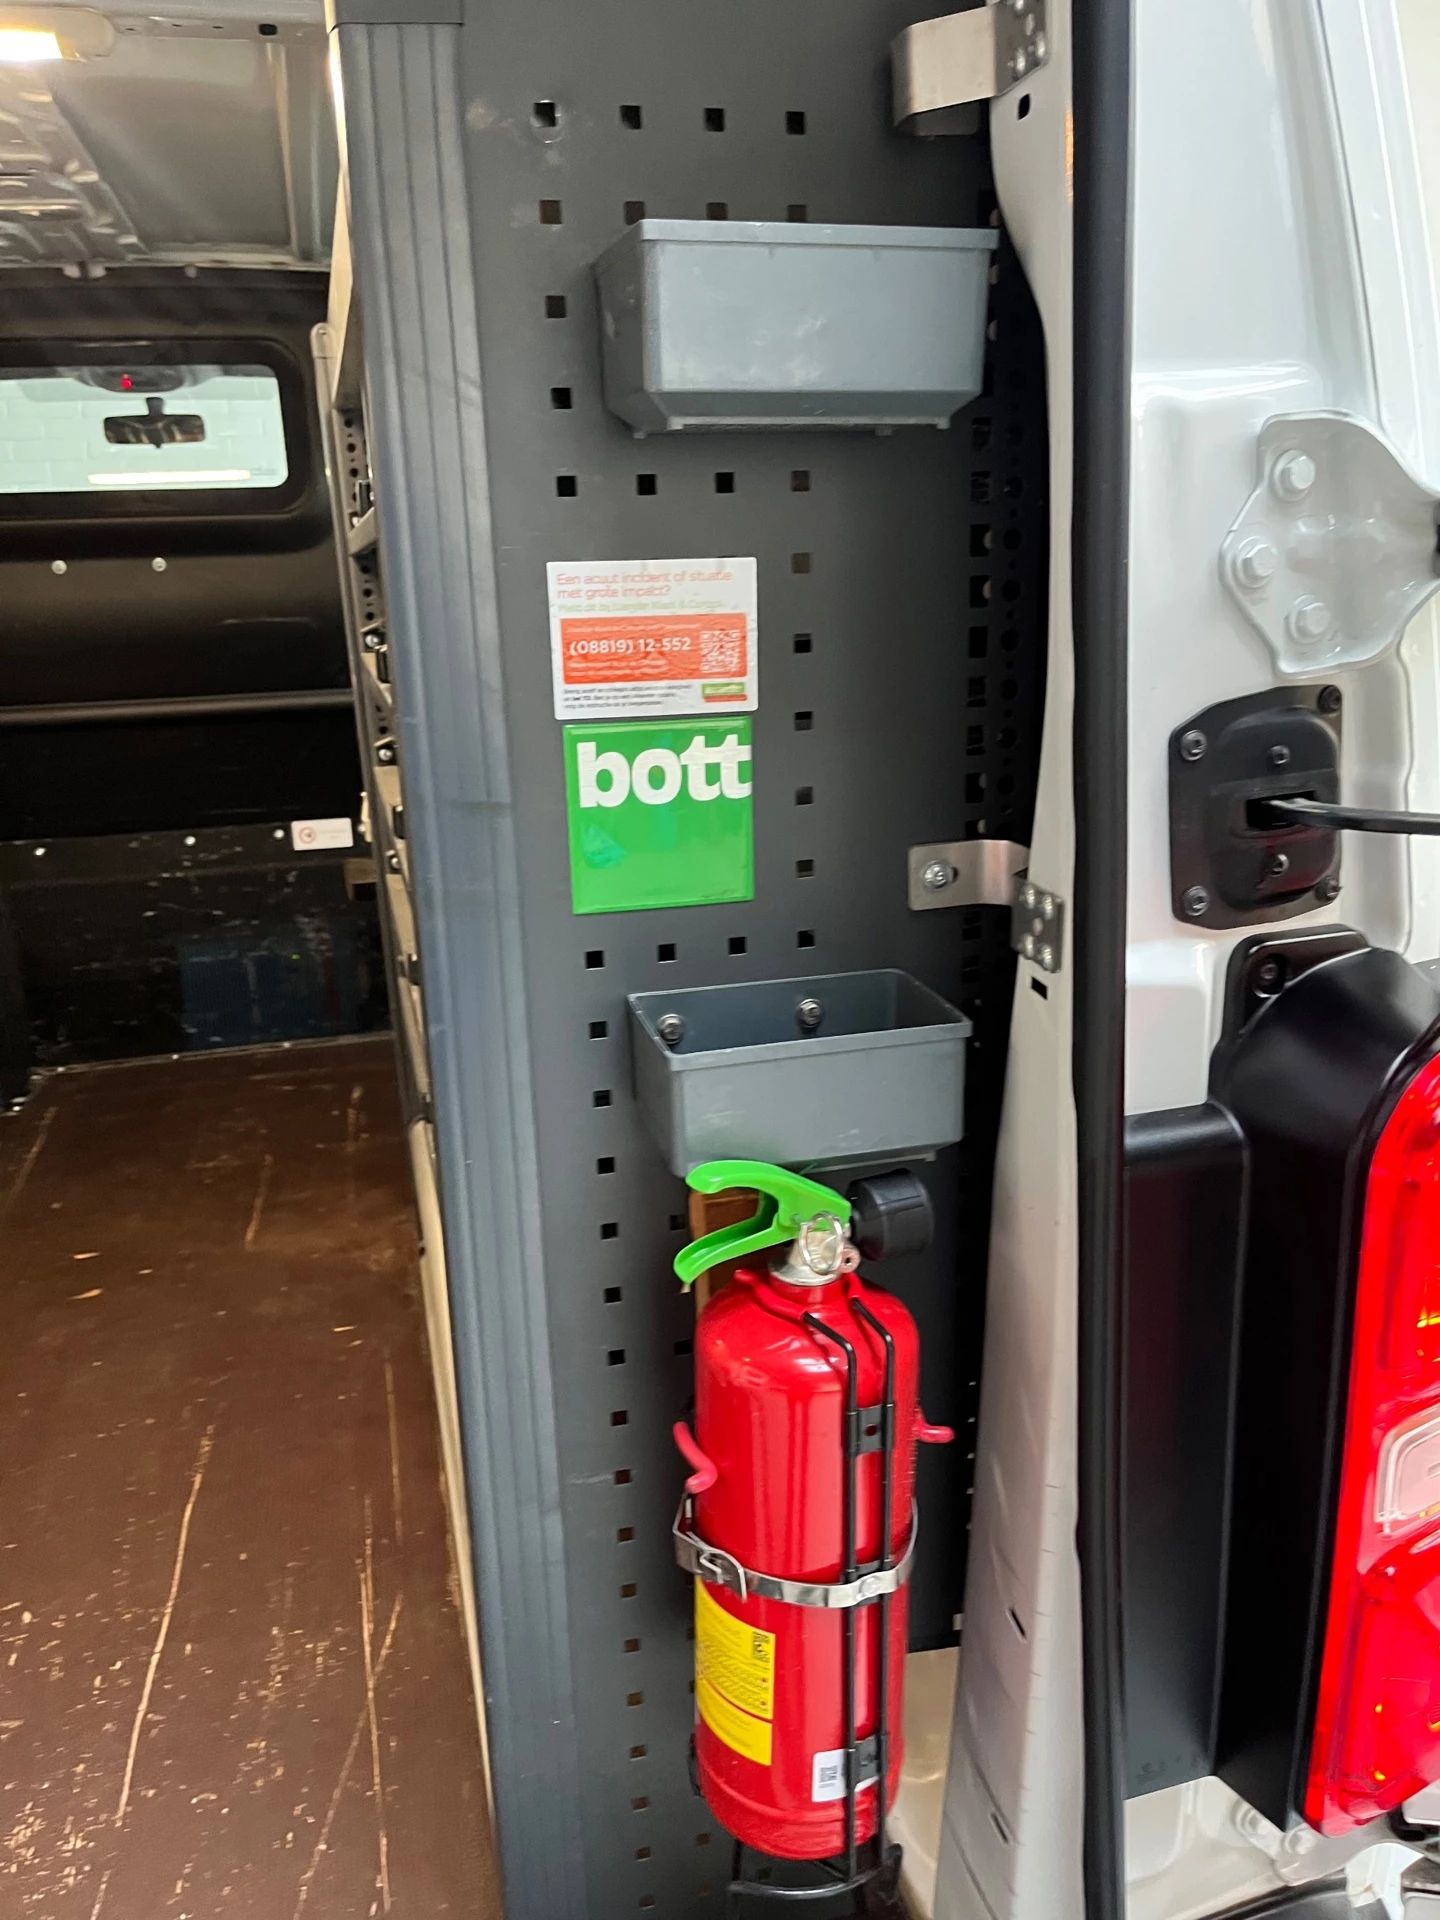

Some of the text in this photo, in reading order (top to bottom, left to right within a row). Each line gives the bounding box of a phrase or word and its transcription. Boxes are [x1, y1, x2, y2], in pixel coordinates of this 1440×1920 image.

[556, 569, 733, 585] Een acuut incident of situatie
[556, 585, 671, 600] met grote impact?
[569, 637, 692, 656] (08819) 12-552
[577, 734, 752, 808] bott
